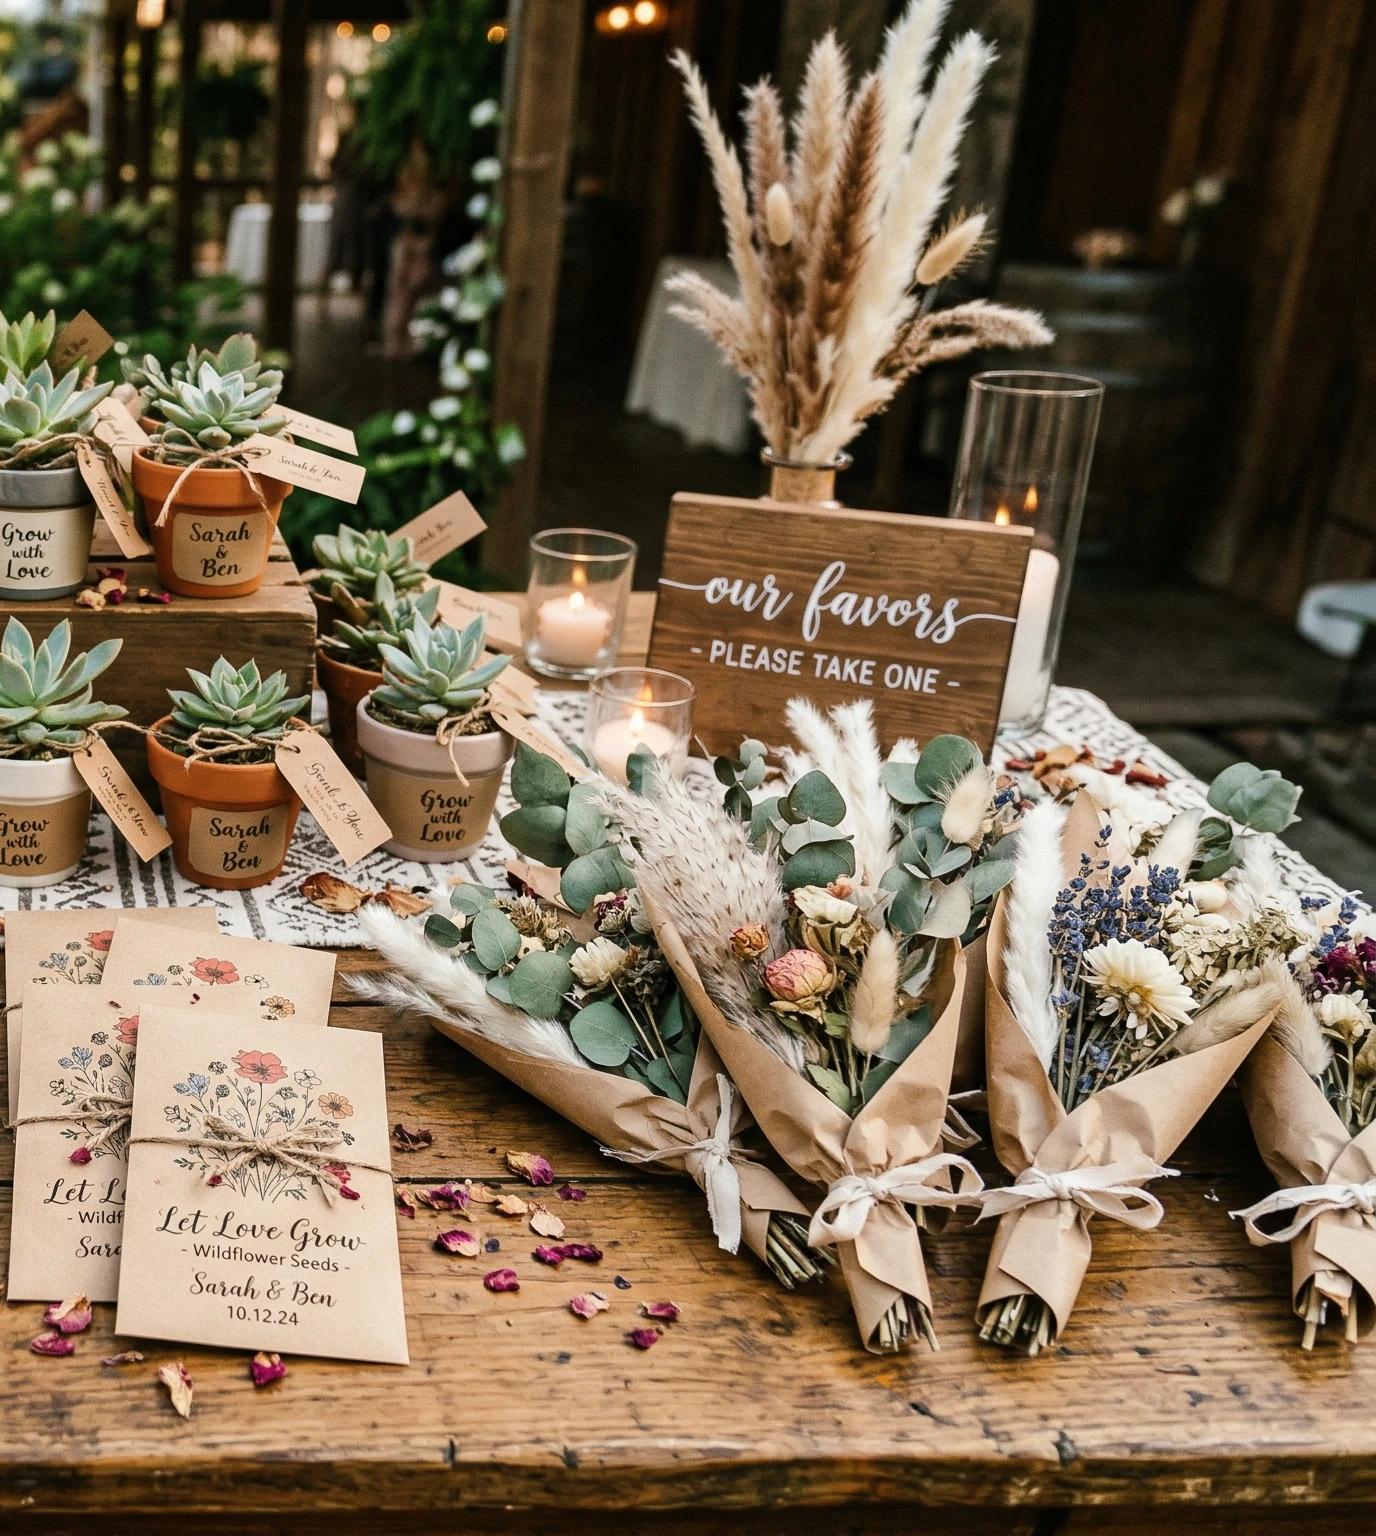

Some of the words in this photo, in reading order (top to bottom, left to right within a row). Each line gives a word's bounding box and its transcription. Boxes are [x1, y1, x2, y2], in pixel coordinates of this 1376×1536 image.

[1, 522, 55, 543] Grow
[189, 521, 252, 543] Sarah
[12, 544, 45, 560] with
[215, 544, 229, 560] &
[5, 559, 53, 579] Love
[201, 558, 242, 578] Ben
[659, 574, 793, 621] our
[802, 560, 1018, 644] favors
[709, 639, 804, 676] PLEASE
[813, 653, 877, 686] TAKE
[884, 664, 941, 694] ONE
[420, 789, 474, 811] Grow
[209, 815, 274, 839] Sarah
[430, 810, 462, 825] with
[6, 833, 40, 849] with
[420, 824, 466, 843] Love
[0, 847, 47, 867] Love
[238, 840, 249, 853] &
[222, 851, 262, 873] Ben
[43, 1178, 95, 1204] Let
[155, 1206, 206, 1236] Let
[215, 1210, 284, 1241] Love
[289, 1217, 368, 1252] Grow
[194, 1243, 286, 1267] Wildflower
[291, 1252, 340, 1274] Seeds
[189, 1270, 261, 1301] Sarah
[266, 1279, 284, 1300] &
[292, 1281, 336, 1309] Ben
[226, 1305, 299, 1327] 10.12.24
